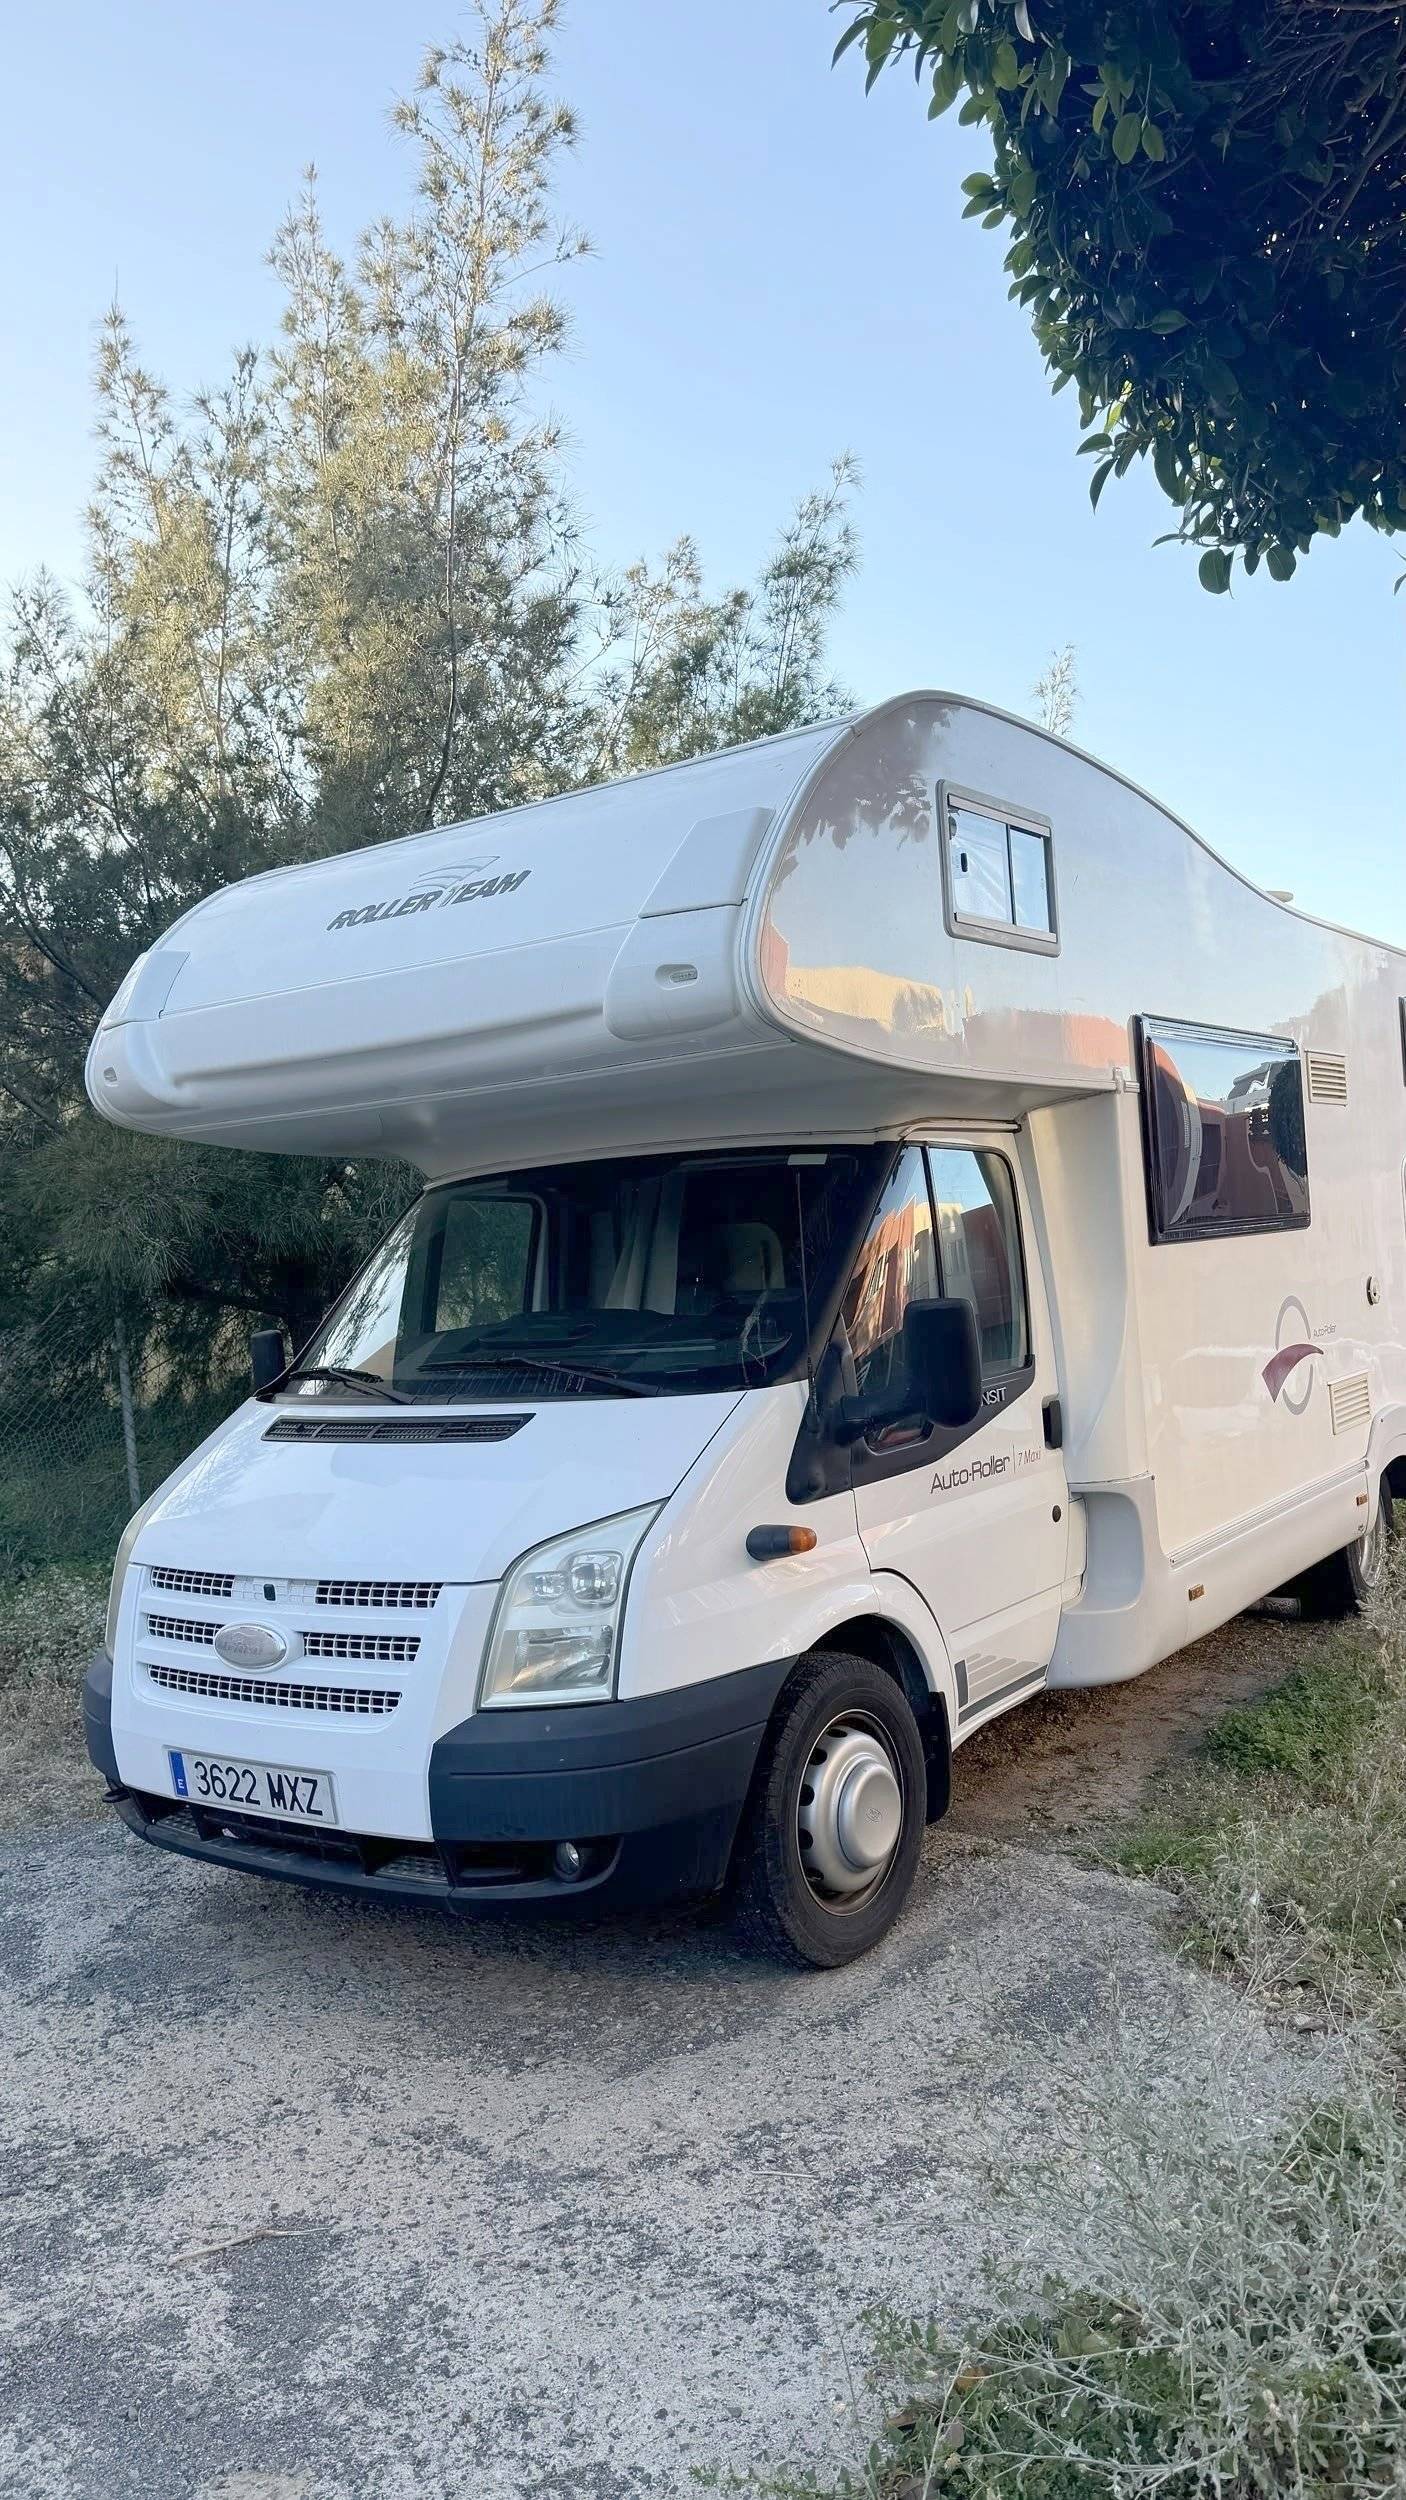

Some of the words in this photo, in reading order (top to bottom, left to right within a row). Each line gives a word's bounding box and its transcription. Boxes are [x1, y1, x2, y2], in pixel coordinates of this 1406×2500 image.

[326, 890, 443, 931] ROLLER
[438, 869, 532, 907] TEAM
[980, 1386, 1007, 1407] NSIT
[1018, 1452, 1023, 1466] 7
[177, 1779, 185, 1789] E
[194, 1761, 261, 1806] 3622
[266, 1772, 324, 1816] MXZ
